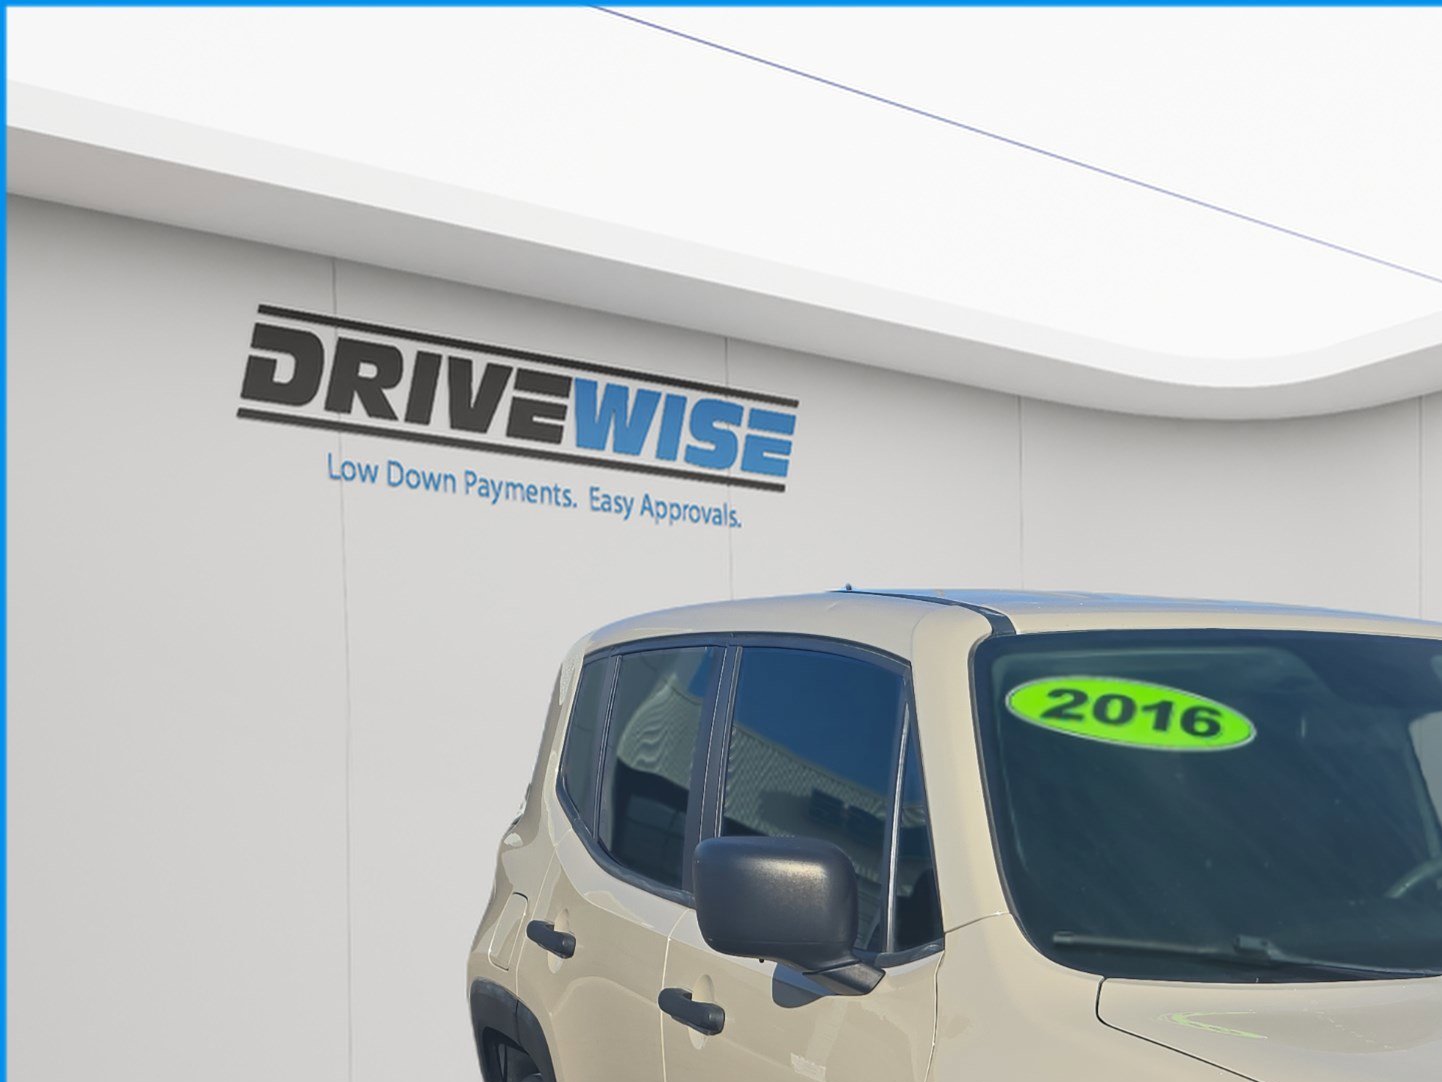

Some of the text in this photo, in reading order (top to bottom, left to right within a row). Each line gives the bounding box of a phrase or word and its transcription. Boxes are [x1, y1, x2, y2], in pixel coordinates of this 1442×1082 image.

[239, 321, 798, 479] DRIVEWISE
[327, 452, 743, 529] Low Down Payments. Easy Approvals.
[1039, 687, 1223, 739] 2016
